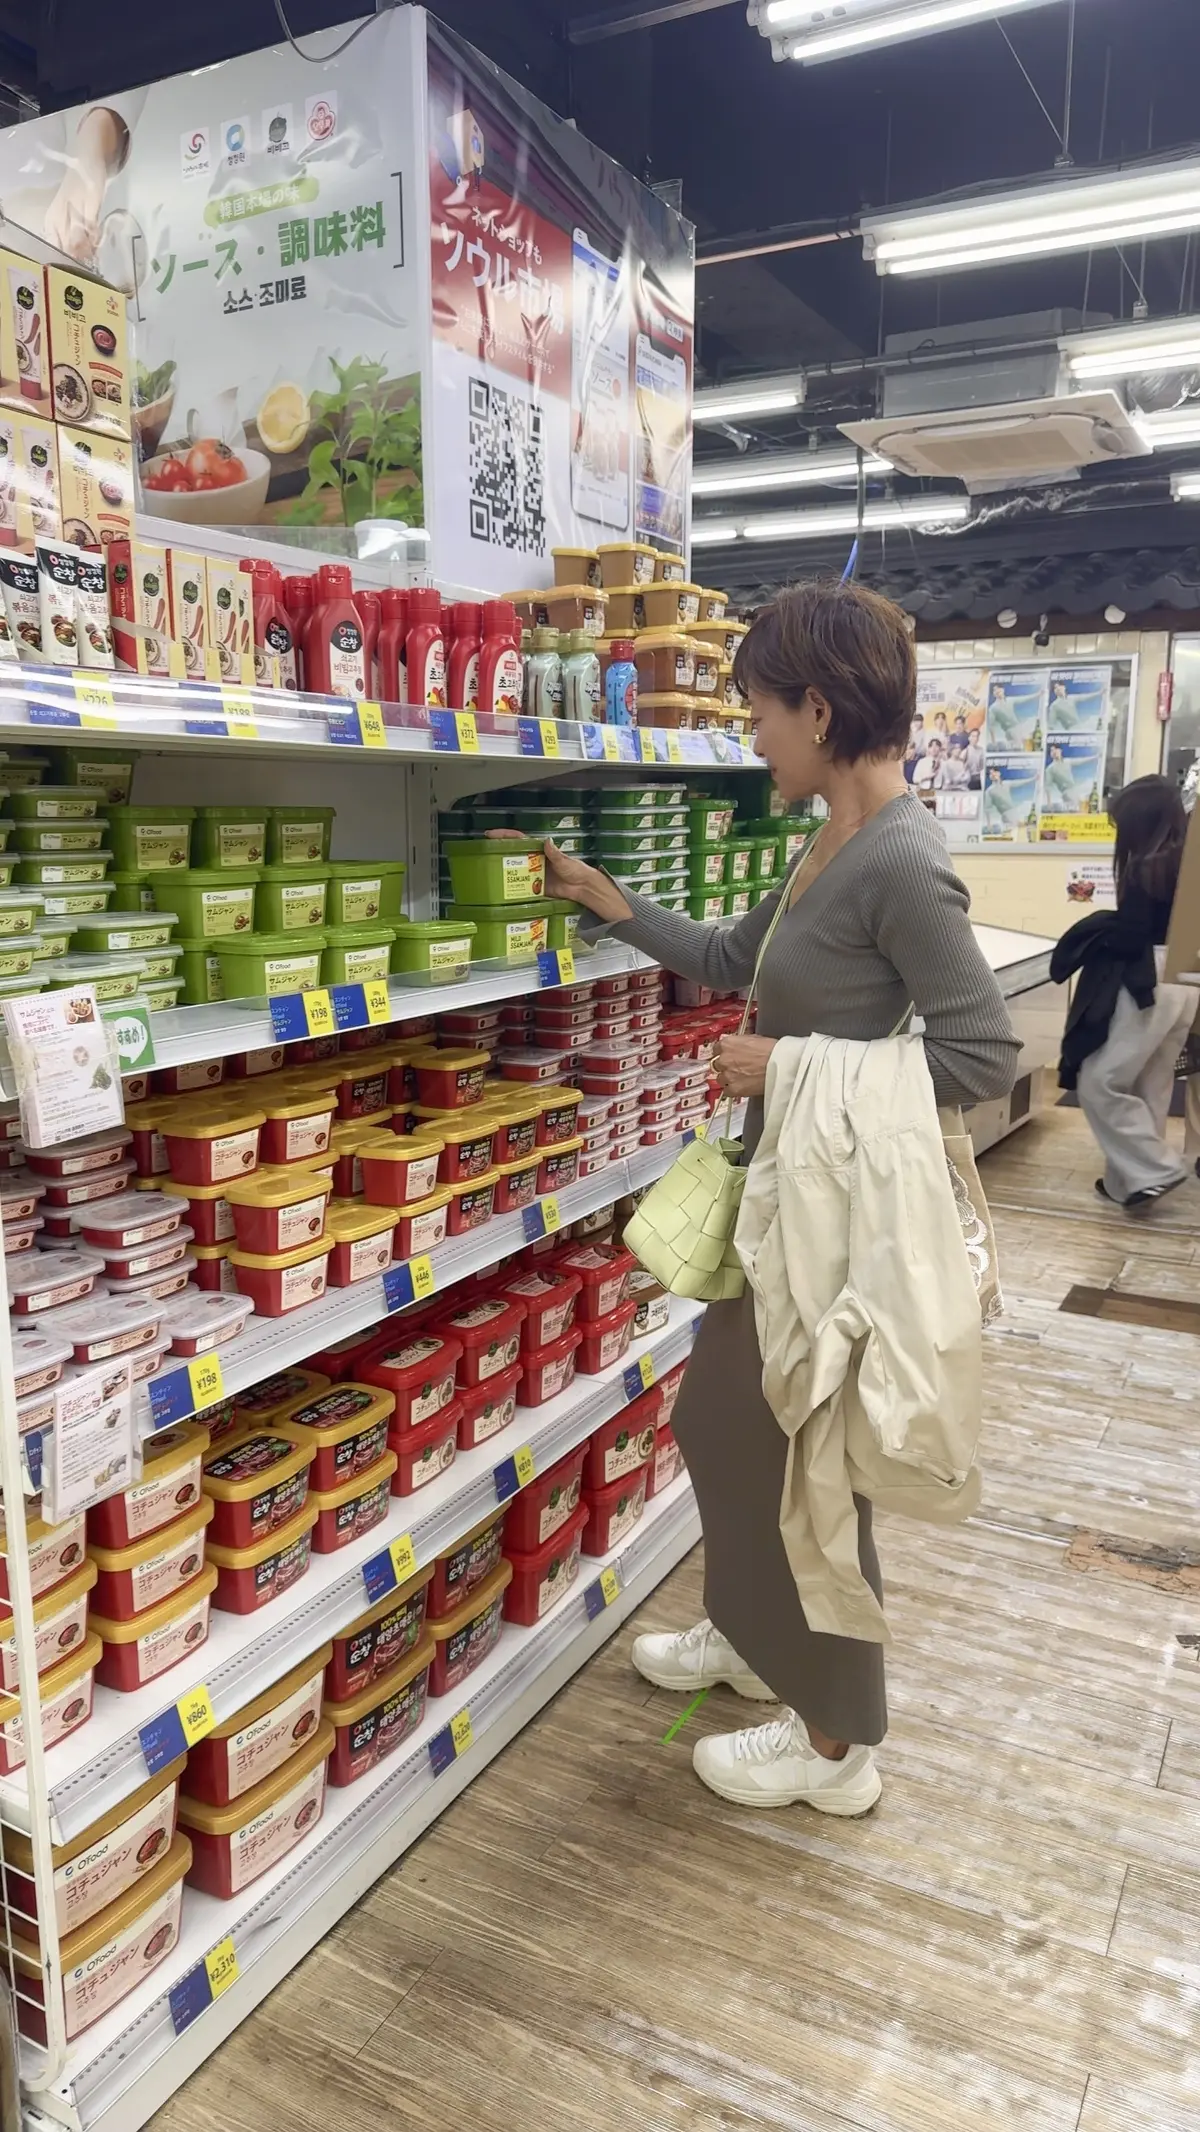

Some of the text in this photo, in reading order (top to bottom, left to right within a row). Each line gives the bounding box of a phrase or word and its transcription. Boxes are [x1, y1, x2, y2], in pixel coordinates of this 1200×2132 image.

[219, 185, 300, 219] 韓国本場の味
[151, 201, 386, 294] ソース・調味料
[223, 275, 307, 315] 소스·조미료
[340, 637, 358, 649] 순창
[507, 876, 531, 884] SSAMJANG
[207, 907, 235, 915] サムジャン
[348, 965, 372, 973] サムジャン
[97, 983, 122, 992] サムジャン
[269, 976, 298, 985] サムジャン
[311, 1006, 328, 1019] ¥198
[371, 998, 386, 1009] ¥344
[196, 1372, 217, 1390] ¥198
[608, 1450, 637, 1472] コチュジャン
[30, 1549, 58, 1572] ュジャン
[396, 1550, 411, 1566] ¥992
[186, 1704, 207, 1725] ¥860
[236, 1724, 289, 1767] コチュジャン
[240, 1815, 291, 1860] コチュジャン
[66, 1847, 132, 1900] コチュジャン
[75, 1944, 140, 2001] コチュジャン
[209, 1952, 235, 1982] ¥2,310
